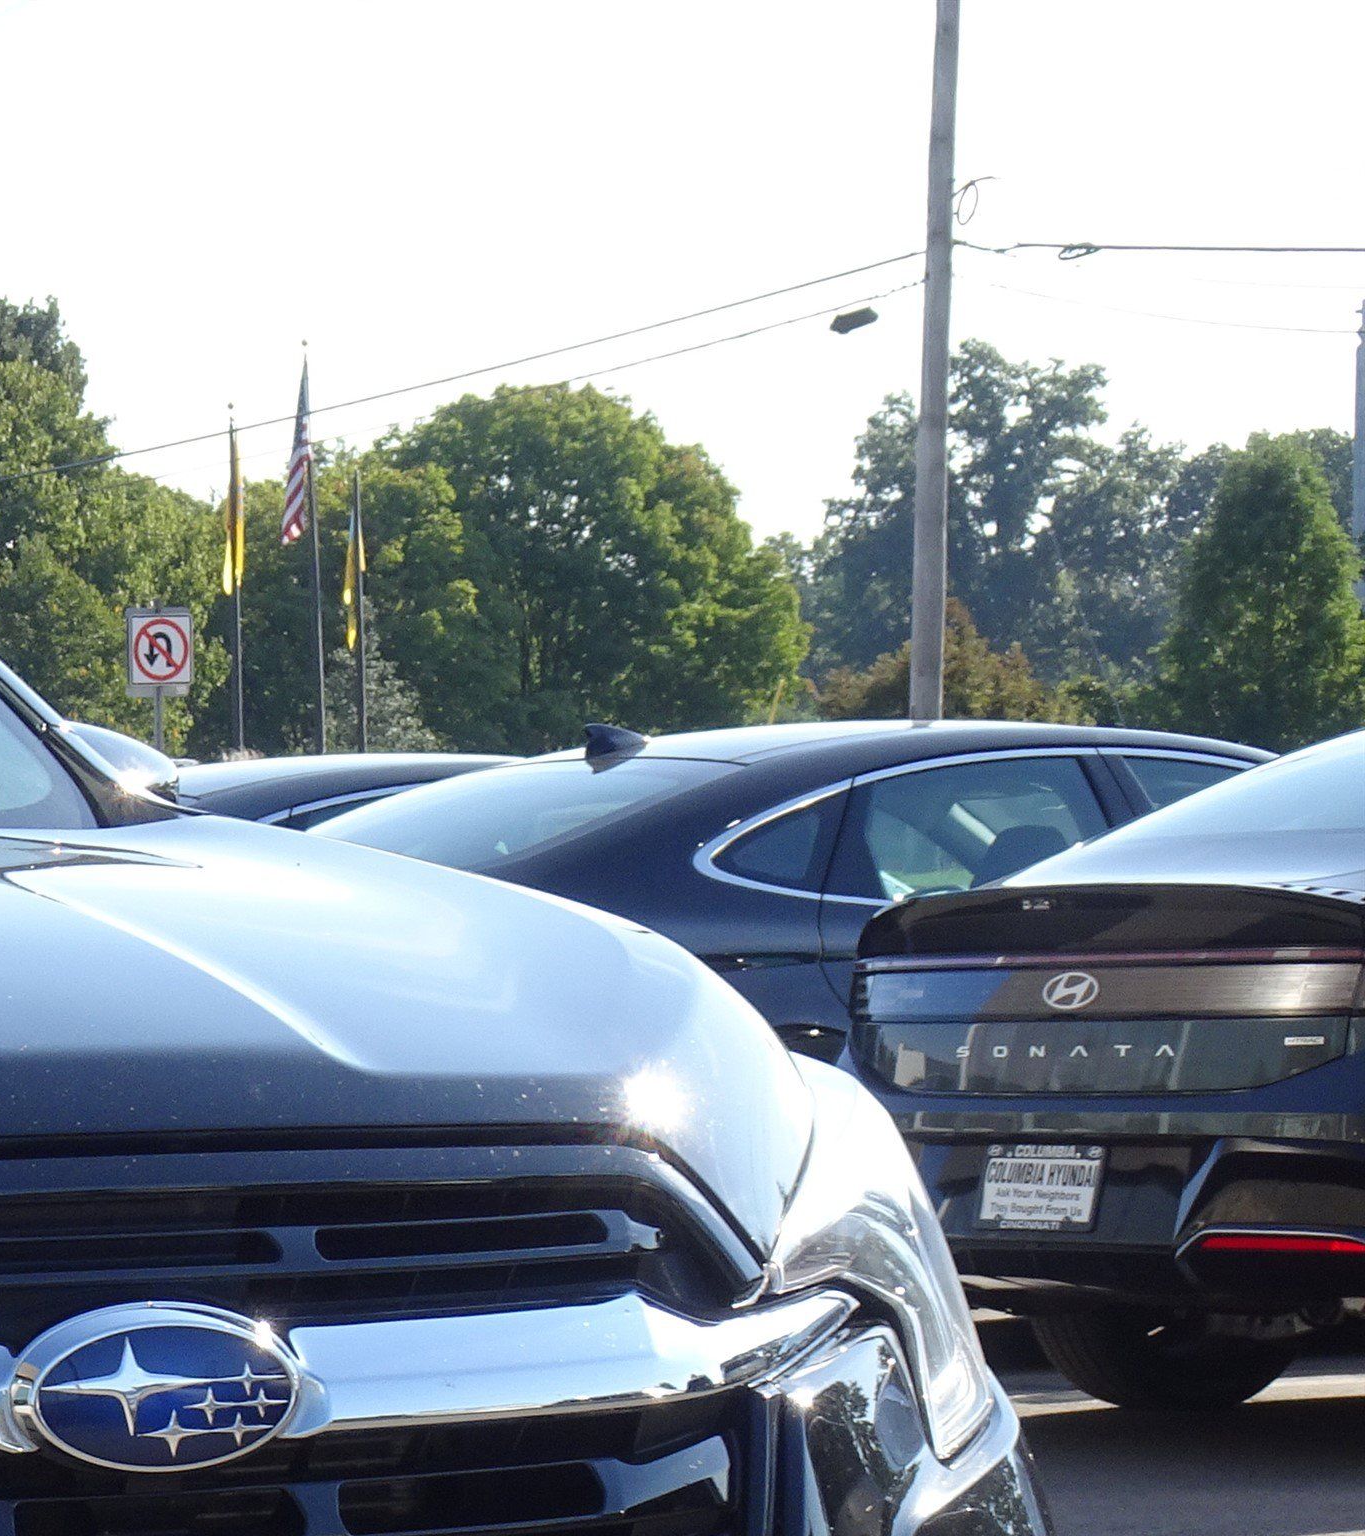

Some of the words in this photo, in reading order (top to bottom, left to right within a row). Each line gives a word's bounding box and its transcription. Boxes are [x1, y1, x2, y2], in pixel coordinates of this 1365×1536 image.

[956, 1044, 1175, 1058] SONATA
[988, 1161, 1044, 1185] COLUMBIA
[1013, 1188, 1032, 1199] Your
[1034, 1189, 1081, 1202] Neighbors
[1010, 1203, 1043, 1216] Bought
[1044, 1205, 1068, 1216] From
[1070, 1205, 1083, 1217] Us
